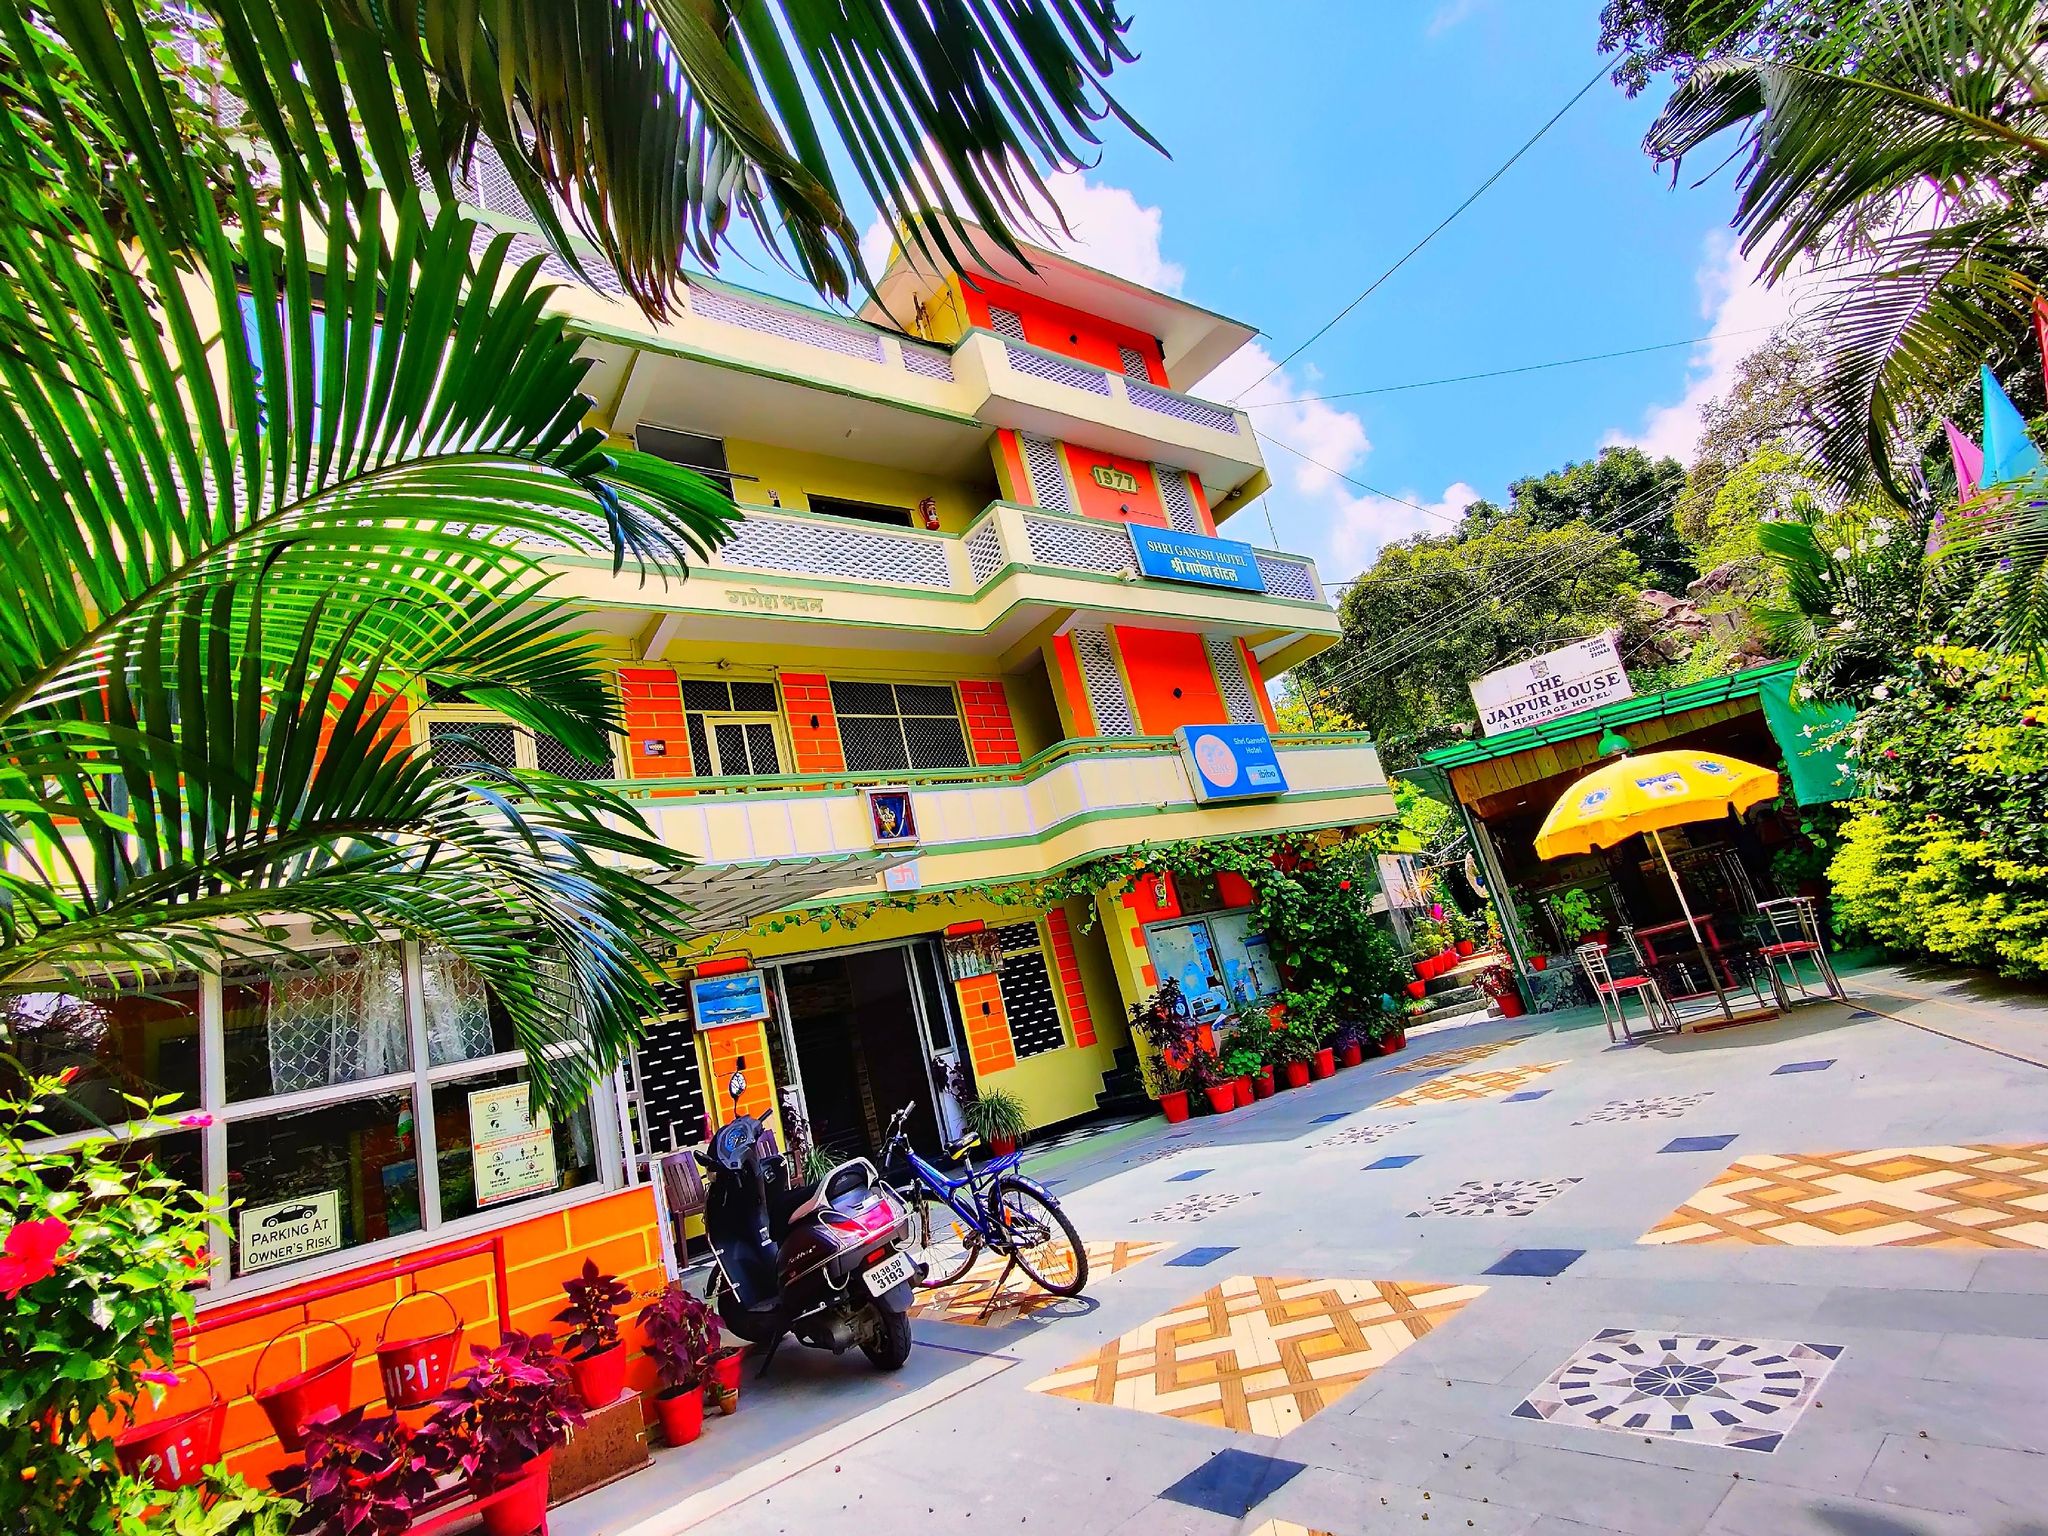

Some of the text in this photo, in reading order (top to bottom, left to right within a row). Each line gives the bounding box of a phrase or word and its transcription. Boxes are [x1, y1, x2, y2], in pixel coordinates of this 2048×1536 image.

[1095, 468, 1133, 490] 1977
[1146, 540, 1174, 555] SHRI
[1174, 545, 1215, 561] GANESH
[1215, 551, 1248, 567] HOTEL
[1171, 557, 1239, 581] श्री गणेश होटल
[1526, 674, 1564, 696] THE
[1486, 672, 1621, 725] JAIPUR HOUSE
[1513, 704, 1568, 727] HERITAGE
[1572, 690, 1613, 708] HOTEL)
[1246, 736, 1267, 745] Ganesh
[251, 1218, 329, 1247] PARKING AT
[248, 1235, 332, 1265] OWNER'S RISK
[876, 1267, 906, 1290] 3193
